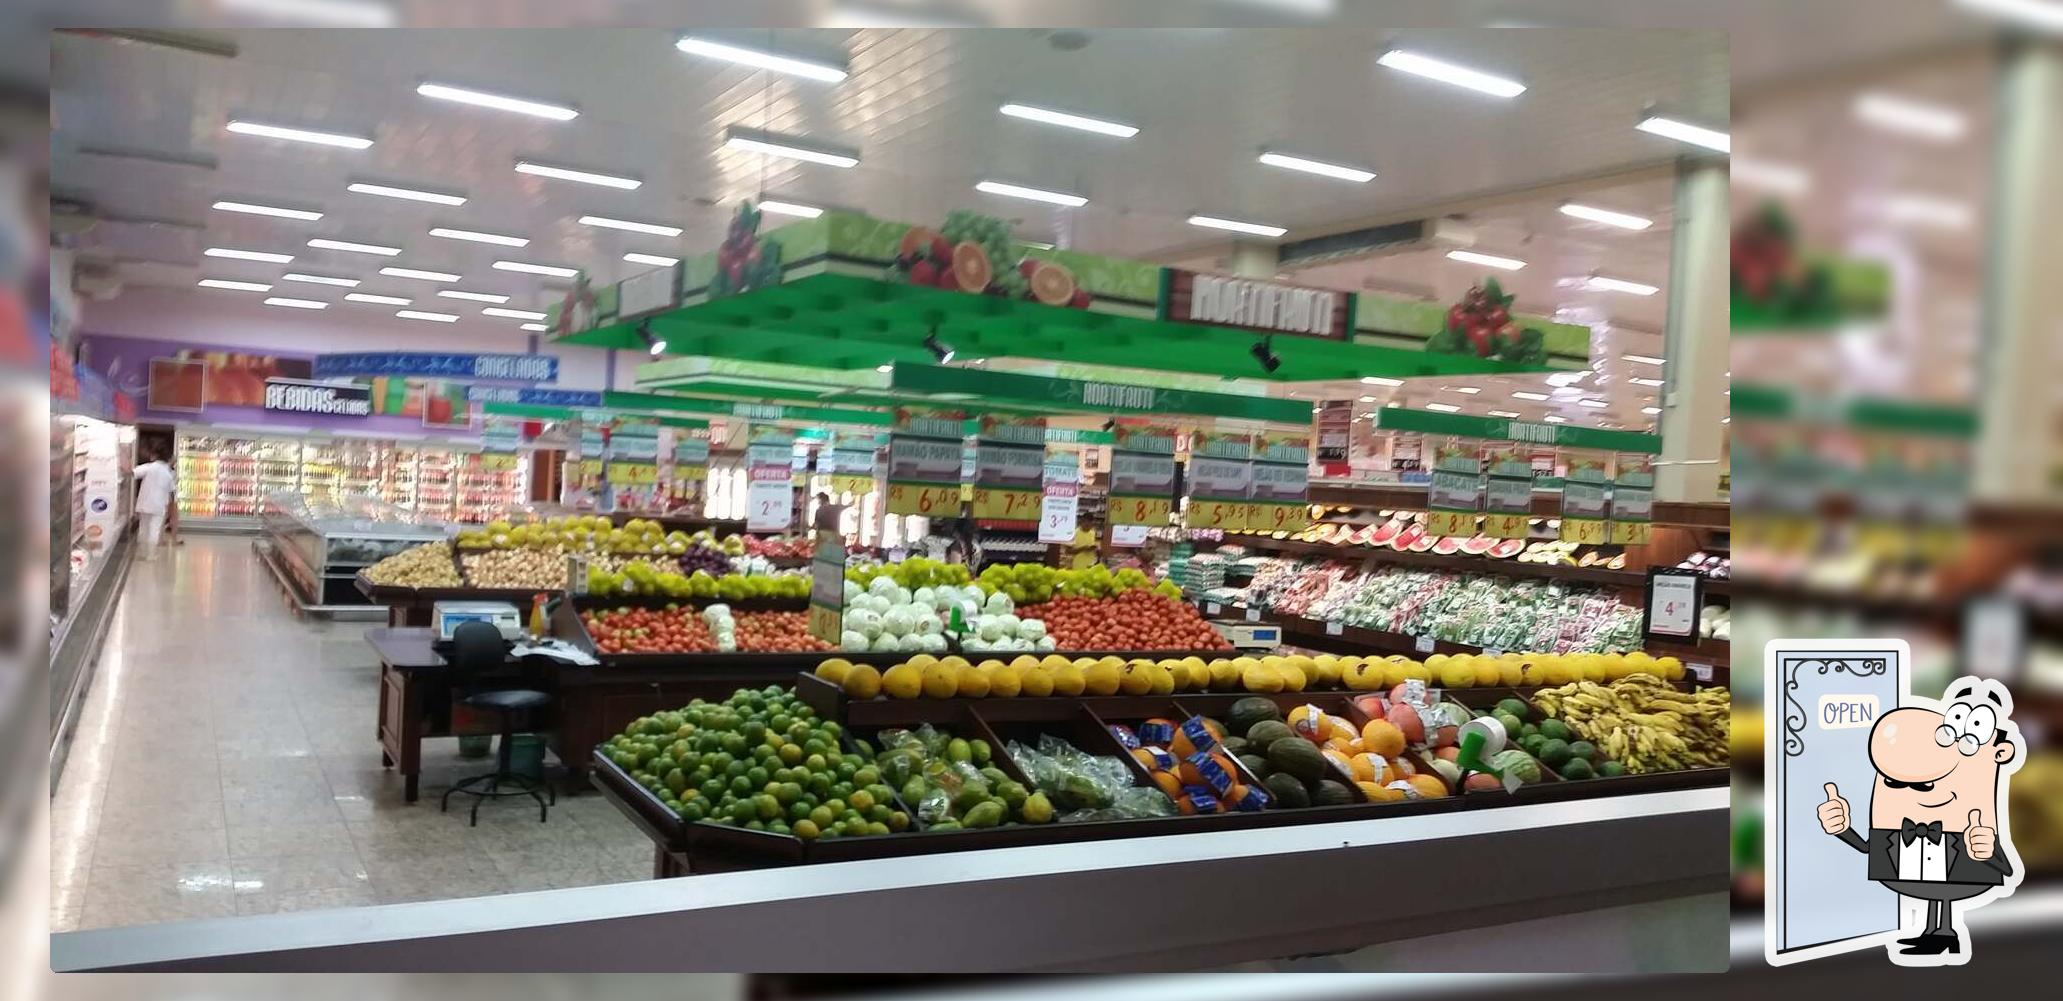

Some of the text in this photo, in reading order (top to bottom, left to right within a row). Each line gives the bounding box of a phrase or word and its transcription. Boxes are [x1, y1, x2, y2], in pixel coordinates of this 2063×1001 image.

[265, 384, 336, 412] BEBIDAS
[1083, 382, 1155, 410] HORTIFRUTI
[1508, 422, 1556, 443] HORTIFRUTI
[754, 469, 788, 480] OFERTA
[919, 489, 958, 513] 6,09
[1046, 486, 1073, 496] OFERTA
[1004, 494, 1041, 515] 7,29
[1111, 501, 1168, 521] R$ 8,19
[1212, 504, 1243, 524] 5,95
